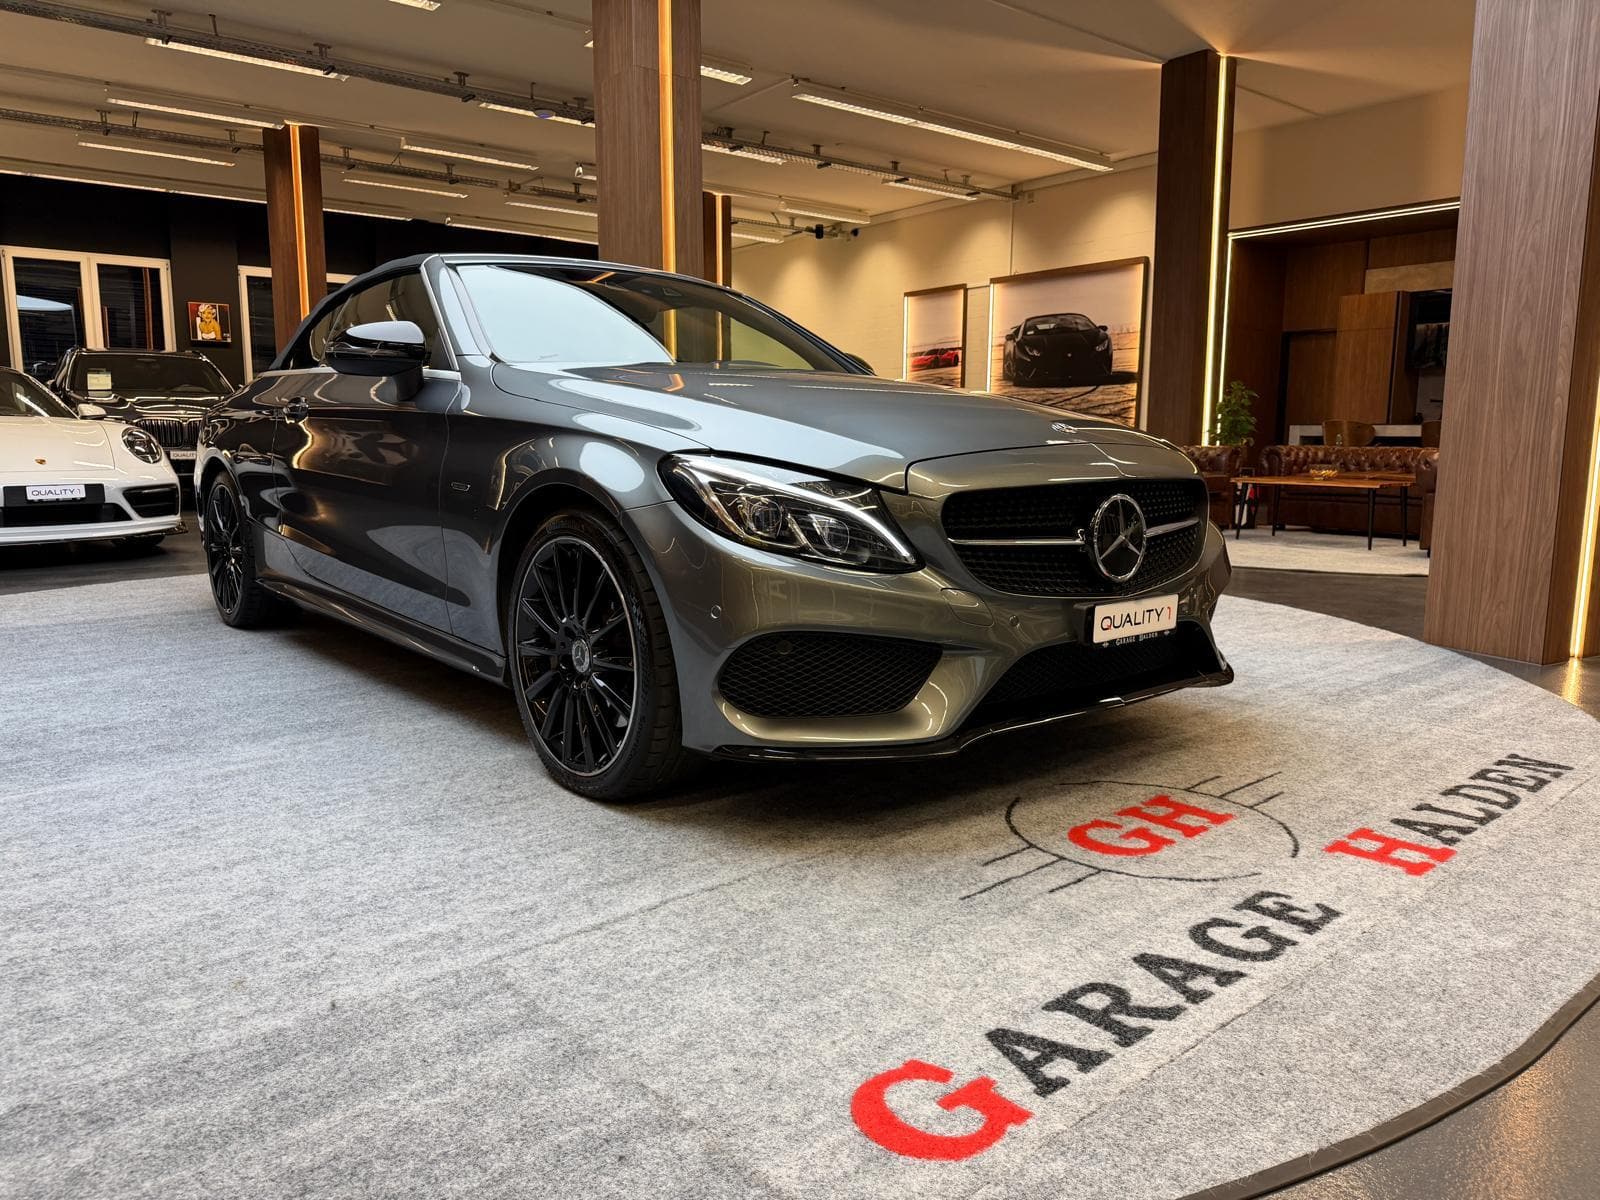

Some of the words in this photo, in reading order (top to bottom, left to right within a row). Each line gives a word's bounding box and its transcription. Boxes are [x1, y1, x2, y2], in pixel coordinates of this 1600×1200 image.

[1067, 794, 1236, 857] GH
[850, 890, 1343, 1162] GARAGE
[1322, 753, 1575, 876] HALDEN
